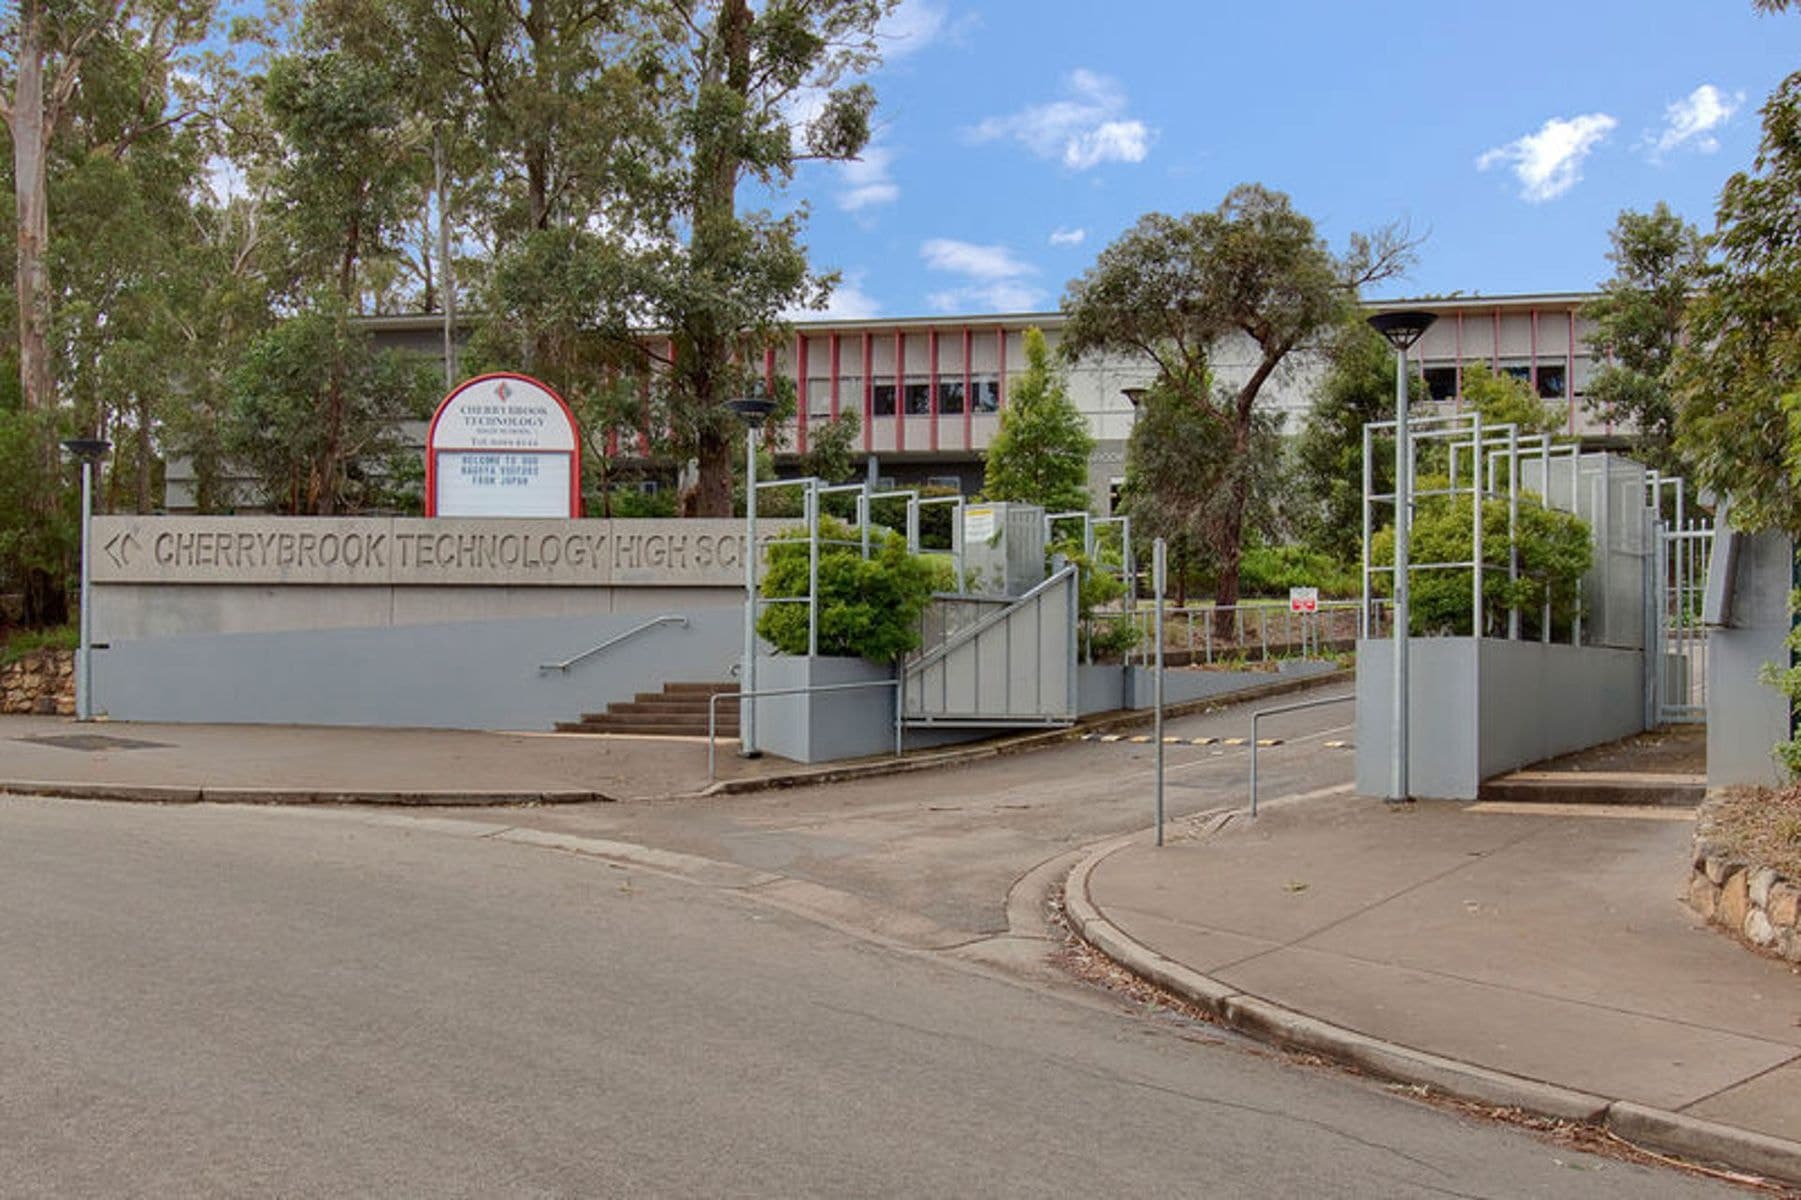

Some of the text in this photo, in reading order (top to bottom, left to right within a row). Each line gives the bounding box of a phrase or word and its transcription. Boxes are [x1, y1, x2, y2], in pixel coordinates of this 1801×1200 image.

[460, 405, 548, 415] CHERRYBROOK
[465, 415, 545, 426] TECHNOLOGY
[154, 531, 387, 568] CHERRYBROOK
[396, 533, 607, 570] TECHNOLOGY
[614, 534, 688, 569] HIGH
